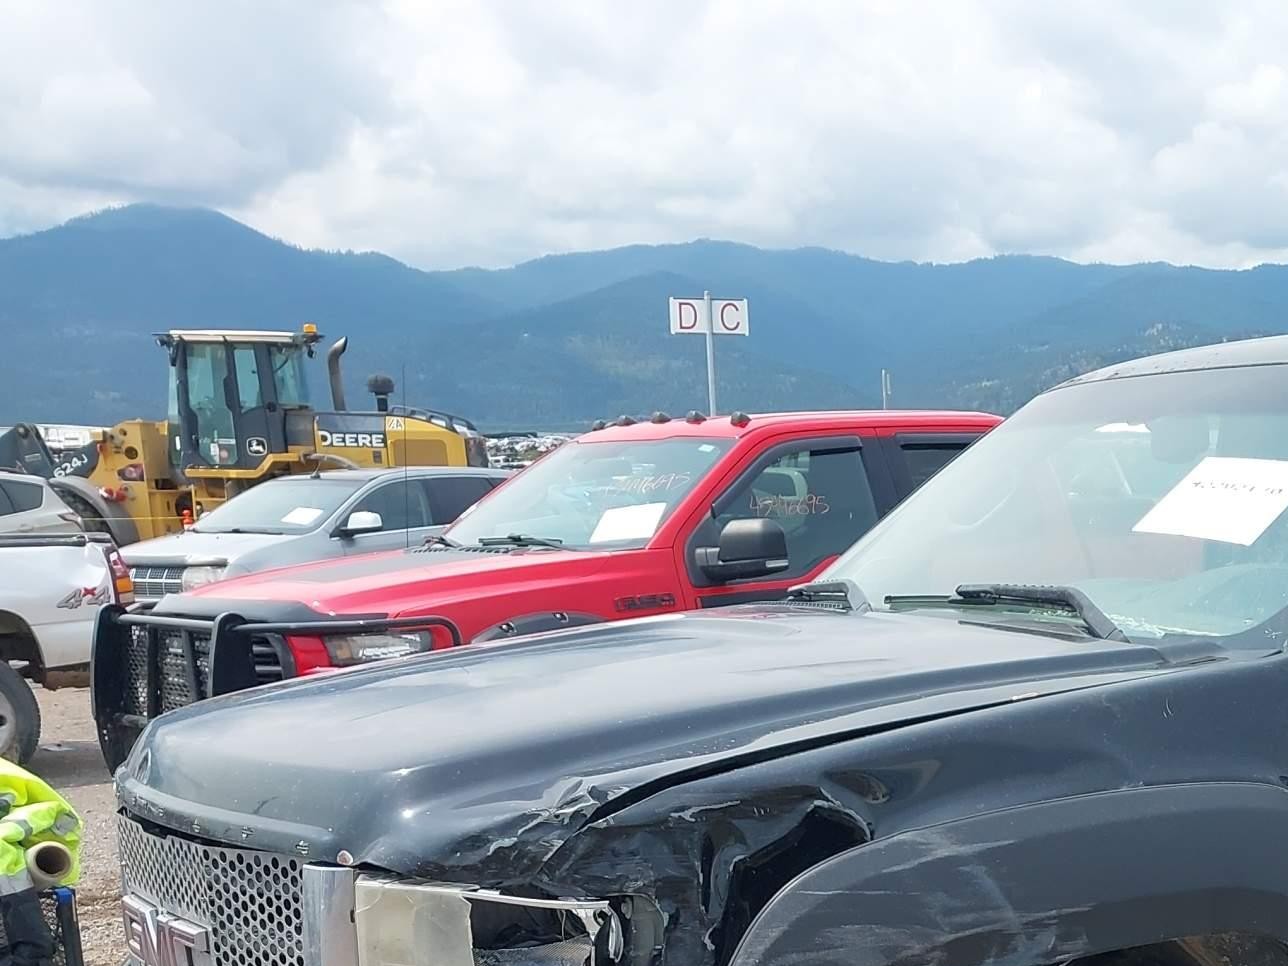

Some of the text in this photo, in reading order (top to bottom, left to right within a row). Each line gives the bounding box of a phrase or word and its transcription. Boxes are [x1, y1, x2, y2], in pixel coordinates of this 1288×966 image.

[678, 302, 741, 331] D C
[318, 430, 385, 448] DEERE
[53, 453, 88, 479] 624J
